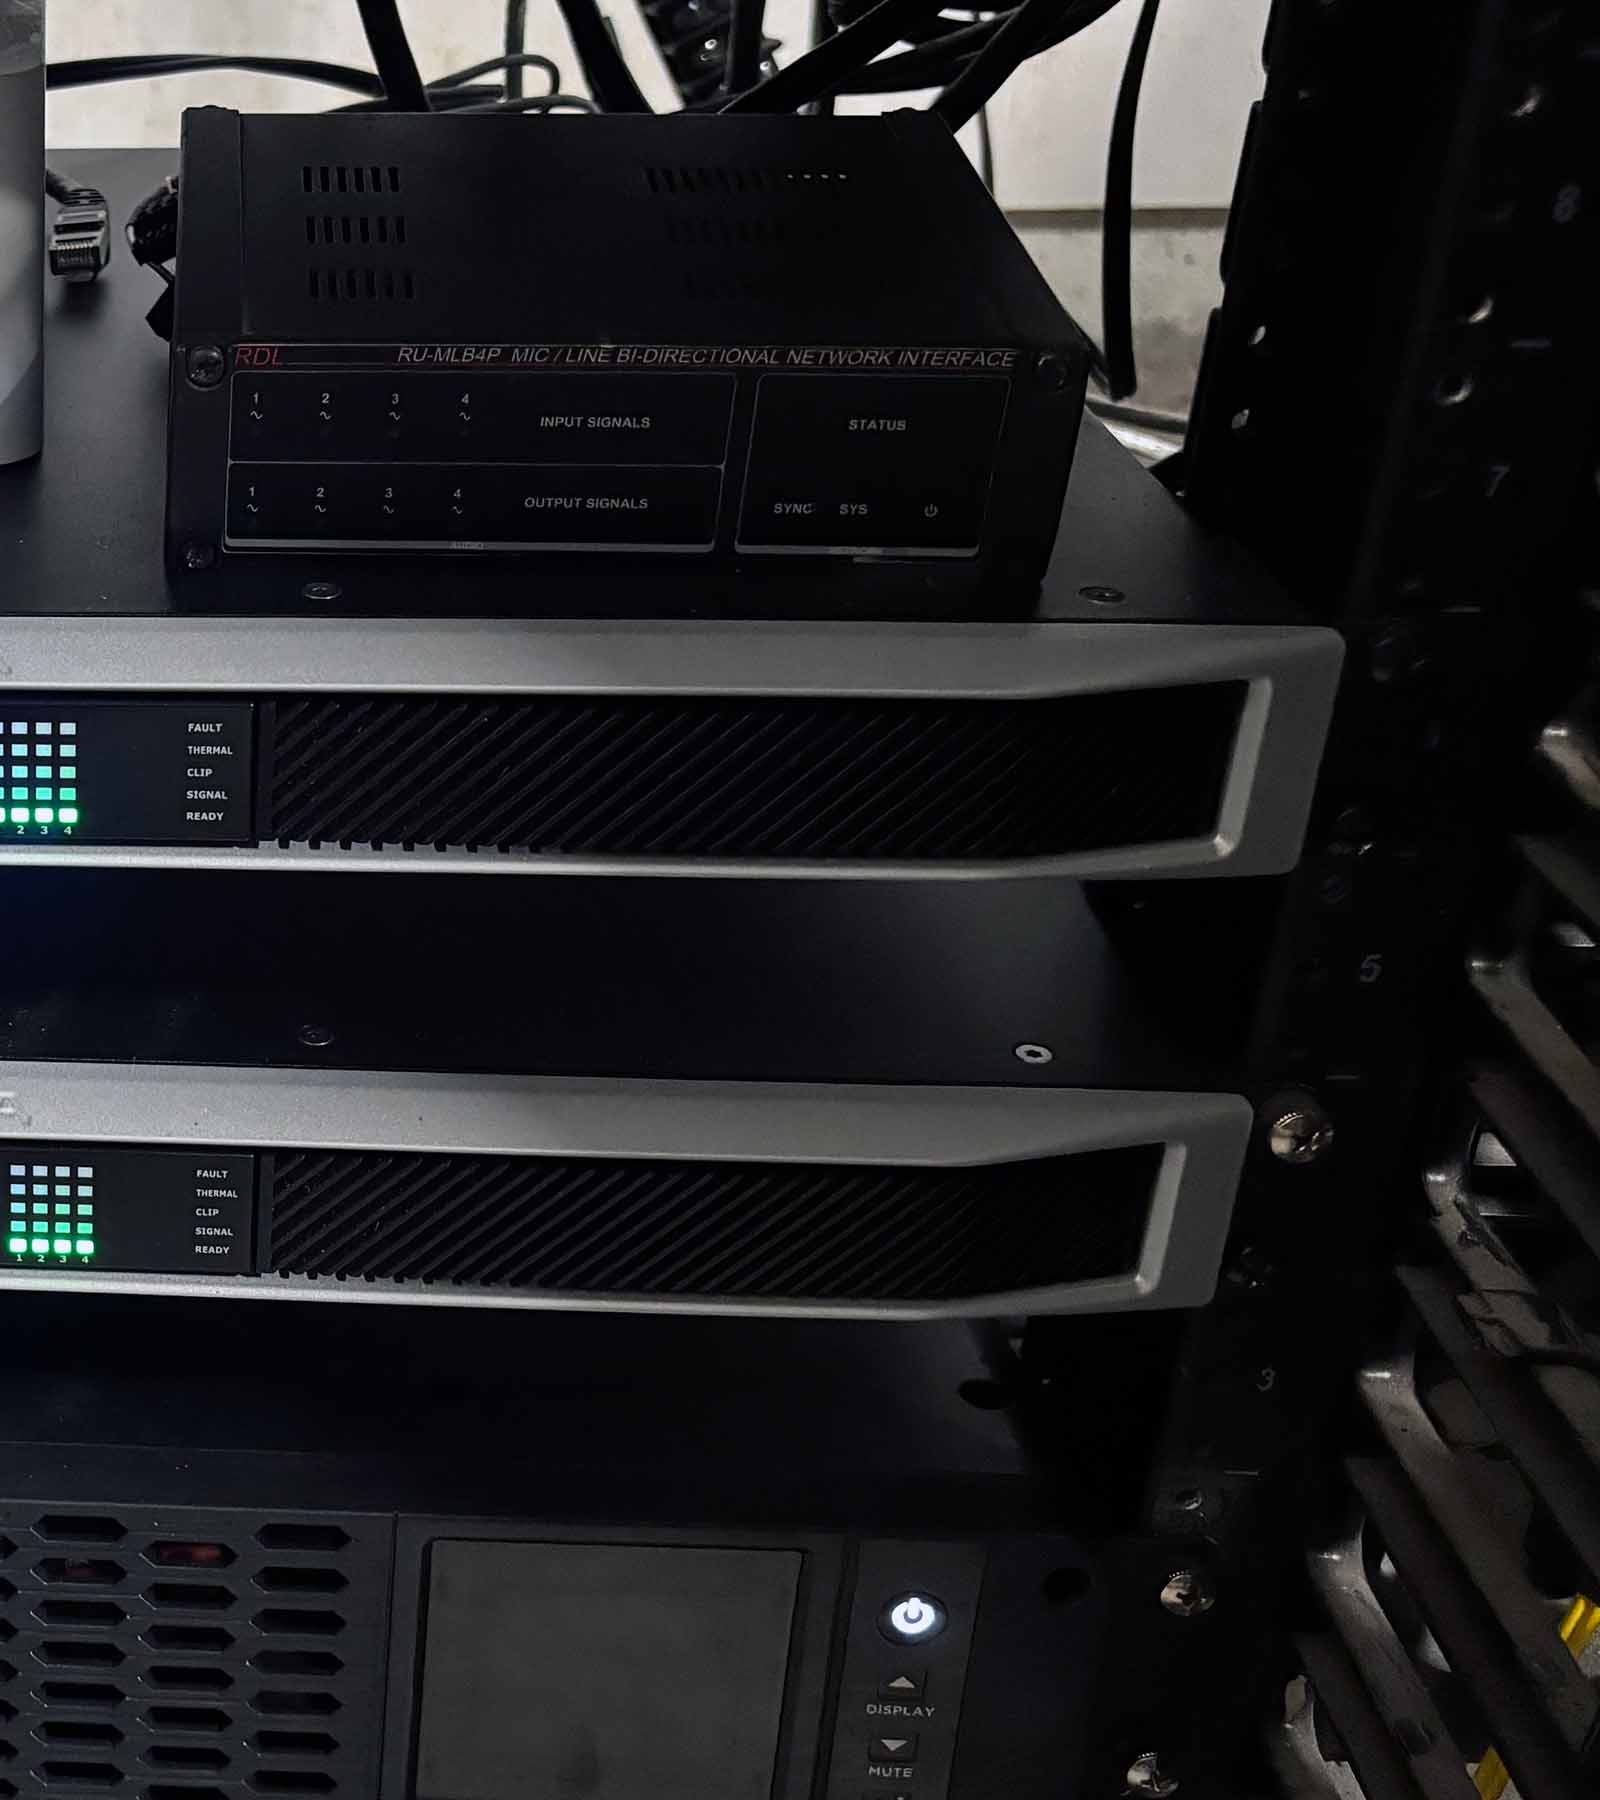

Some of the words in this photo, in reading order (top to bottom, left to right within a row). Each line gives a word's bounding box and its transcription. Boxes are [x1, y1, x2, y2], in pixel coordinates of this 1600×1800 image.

[234, 347, 284, 367] RDL
[397, 346, 502, 363] RU-MLB4P
[511, 347, 550, 363] MIC
[565, 347, 611, 363] LINE
[616, 347, 780, 365] BI-DIRECTIONAL
[786, 349, 892, 366] NETWORK
[897, 349, 1017, 368] INTERFACE
[253, 393, 259, 404] 1
[321, 393, 330, 404] 2
[391, 393, 399, 404] 3
[461, 393, 470, 404] 4
[540, 416, 583, 428] INPUT
[587, 416, 651, 429] SIGNALS
[848, 419, 907, 432] STATUS
[316, 487, 325, 498] 2
[385, 488, 393, 498] 3
[453, 488, 462, 499] 4
[524, 497, 582, 509] OUTPUT
[586, 498, 649, 510] SIGNALS
[773, 503, 813, 515] SYNC
[839, 503, 868, 516] SYS
[187, 723, 223, 733] FAULT
[187, 745, 233, 755] THERMAL
[186, 768, 213, 777] CLIP
[186, 790, 229, 800] SIGNAL
[186, 812, 224, 821] READY
[16, 825, 25, 835] 2
[40, 825, 49, 836] 3
[63, 825, 72, 836] 4
[1359, 952, 1383, 983] 5
[196, 1169, 229, 1179] FAULT
[195, 1188, 239, 1198] THERMAL
[195, 1207, 220, 1217] CLIP
[195, 1226, 234, 1237] SIGNAL
[194, 1245, 230, 1254] READY
[15, 1253, 23, 1263] 1
[37, 1254, 45, 1264] 2
[58, 1255, 67, 1264] 3
[80, 1255, 89, 1265] 4
[1255, 1366, 1277, 1392] 3
[866, 1703, 936, 1718] DISPLAY
[868, 1765, 914, 1779] MUTE
